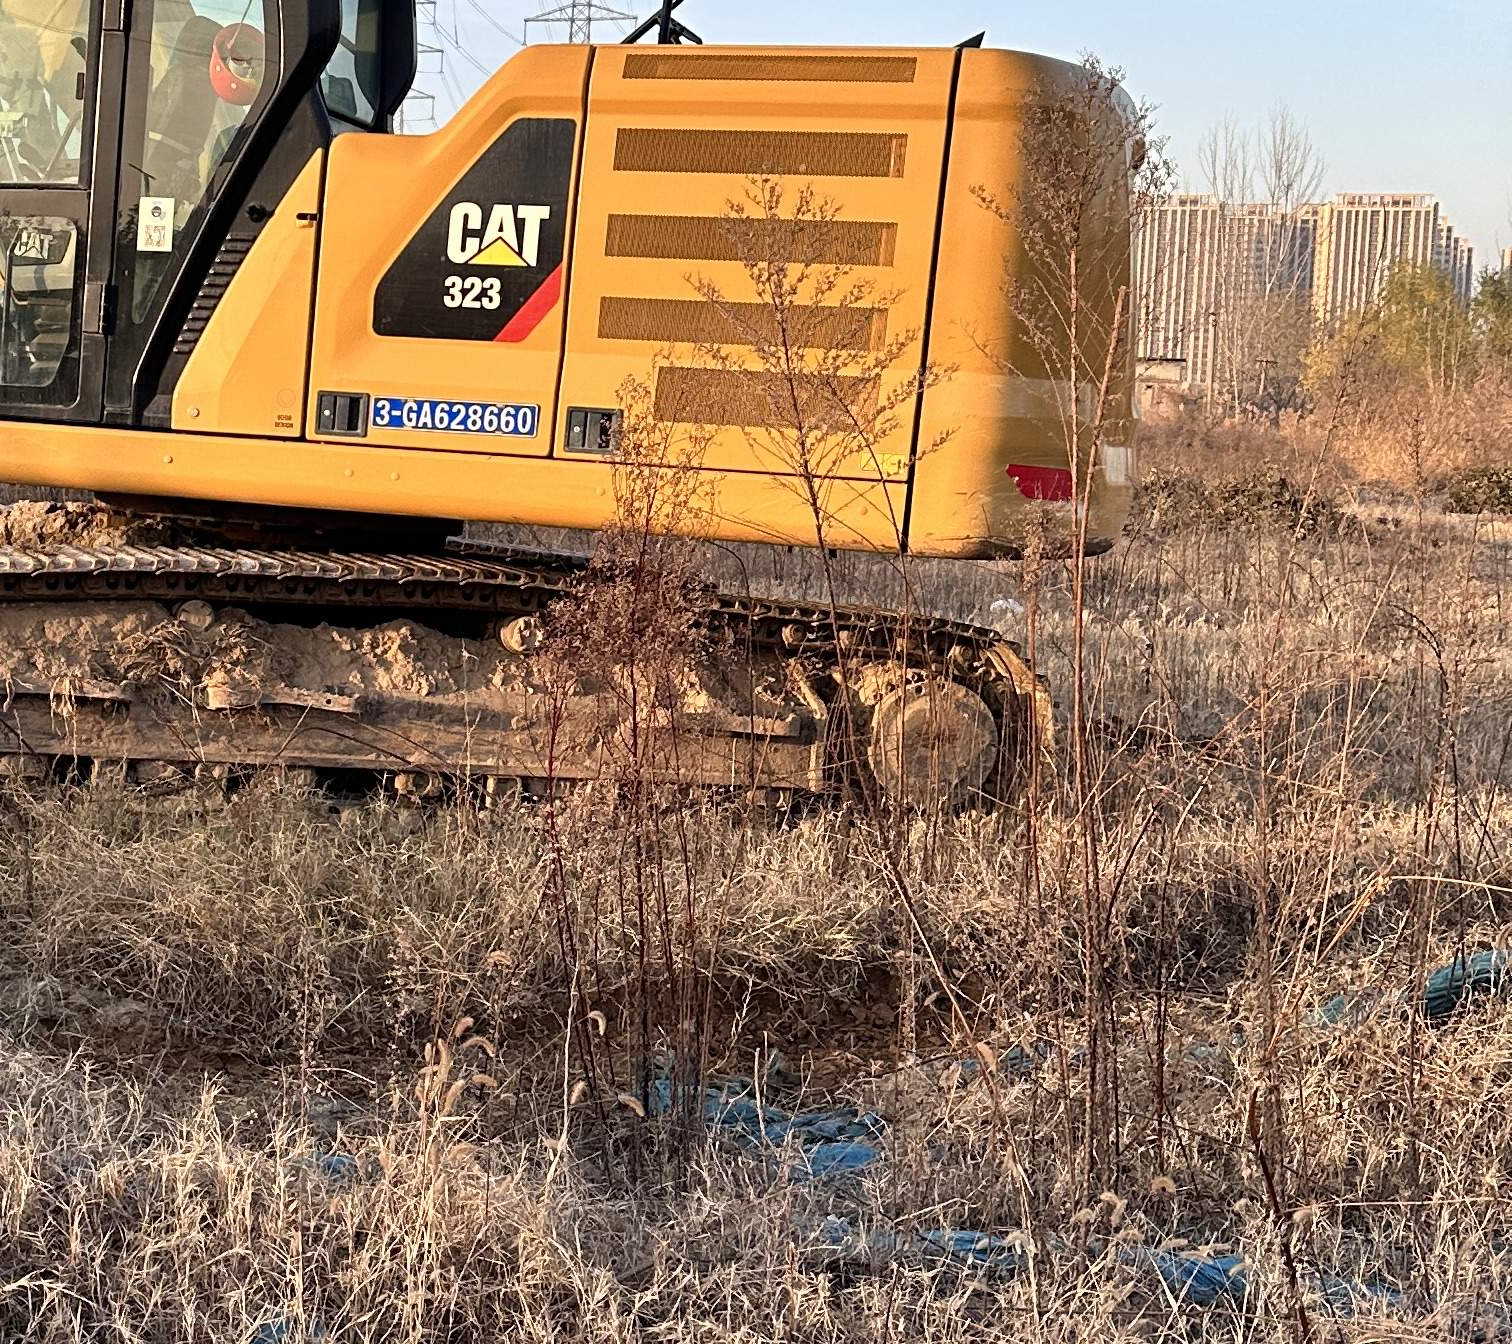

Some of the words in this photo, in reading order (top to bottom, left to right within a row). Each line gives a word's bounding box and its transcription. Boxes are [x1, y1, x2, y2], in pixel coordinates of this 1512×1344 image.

[13, 229, 54, 260] CAT
[447, 201, 551, 267] CAT
[443, 275, 502, 310] 323
[375, 399, 533, 434] 3-GA628660
